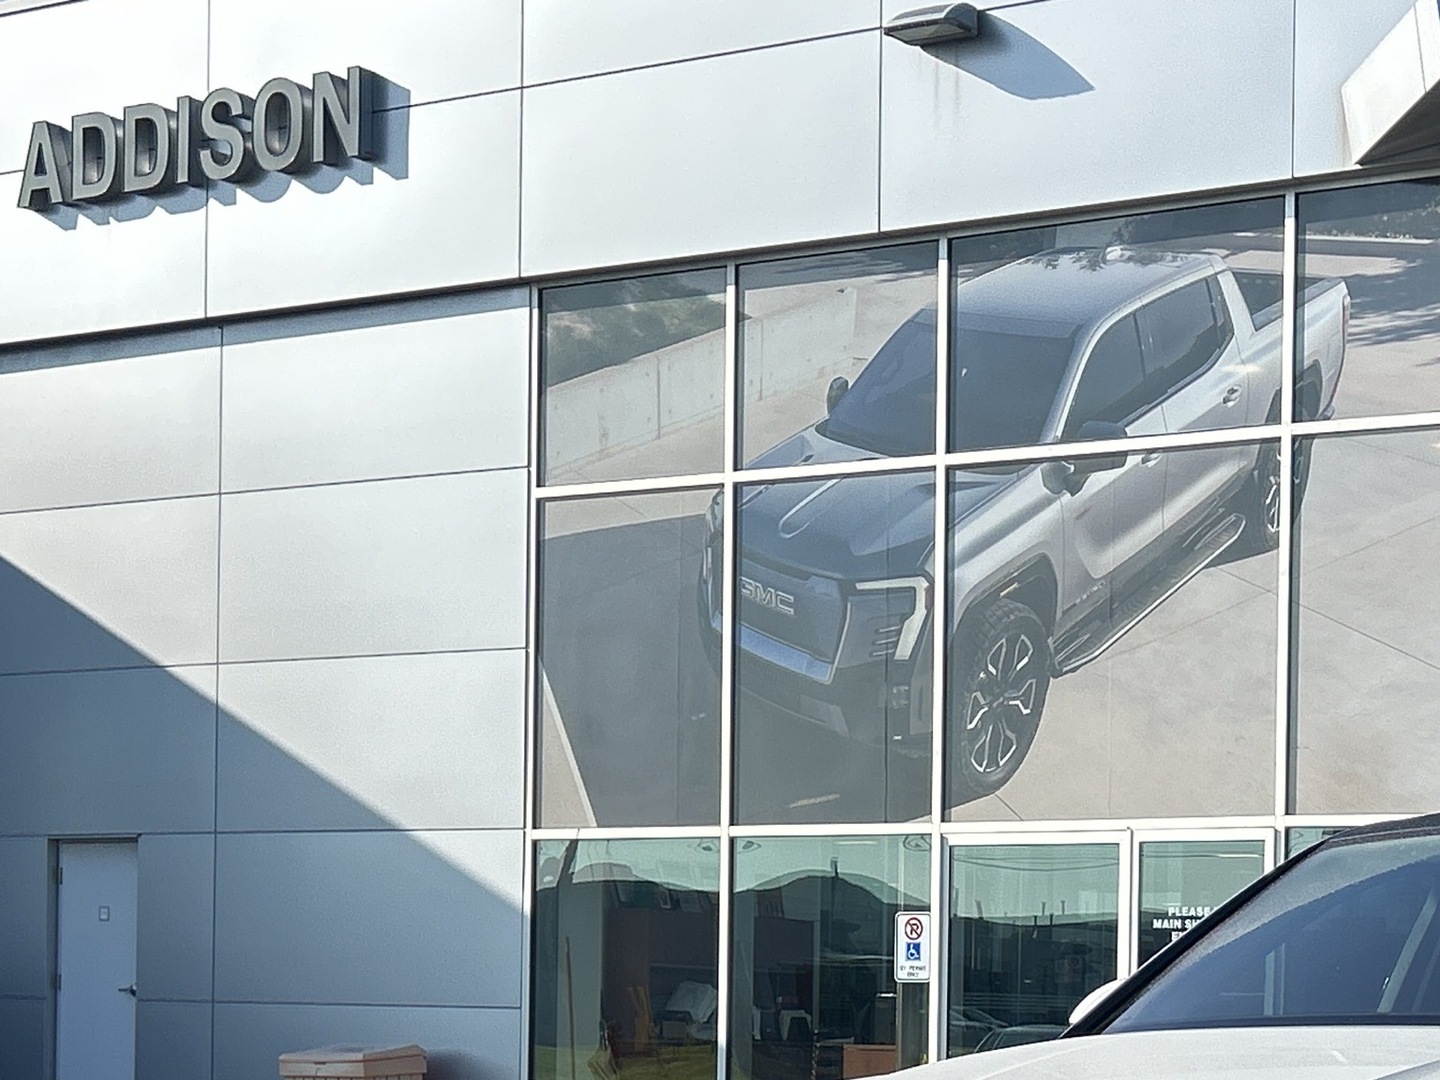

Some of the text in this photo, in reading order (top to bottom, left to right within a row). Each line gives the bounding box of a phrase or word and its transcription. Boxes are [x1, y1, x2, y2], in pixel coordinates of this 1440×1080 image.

[18, 66, 366, 208] ADDISON
[1167, 906, 1210, 917] PLEASE
[1152, 918, 1182, 929] MAIN
